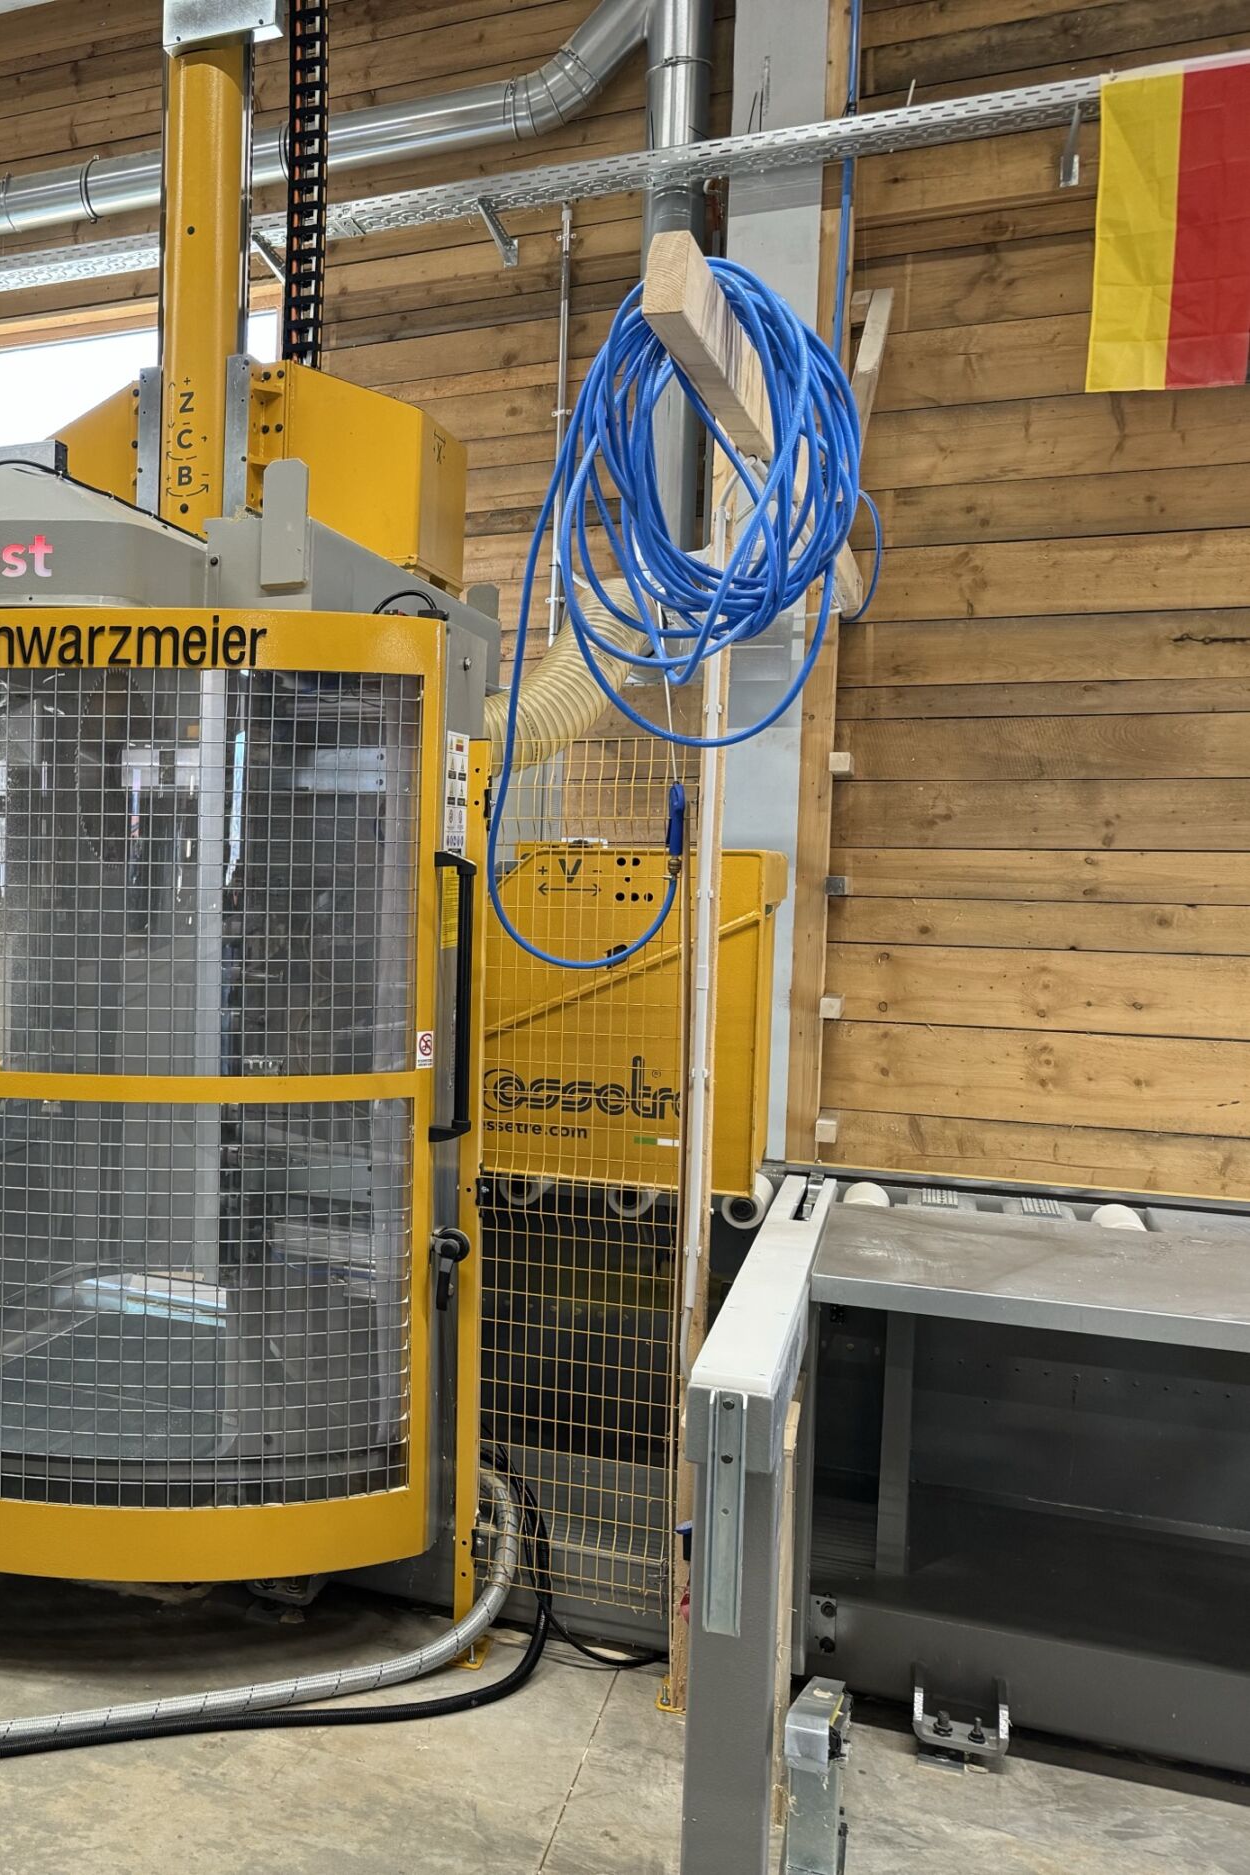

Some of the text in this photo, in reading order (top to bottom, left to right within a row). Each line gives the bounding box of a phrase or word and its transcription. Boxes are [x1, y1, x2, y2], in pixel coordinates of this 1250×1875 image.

[179, 391, 194, 414] Z
[176, 428, 193, 449] C
[177, 465, 193, 486] B
[558, 858, 583, 884] V
